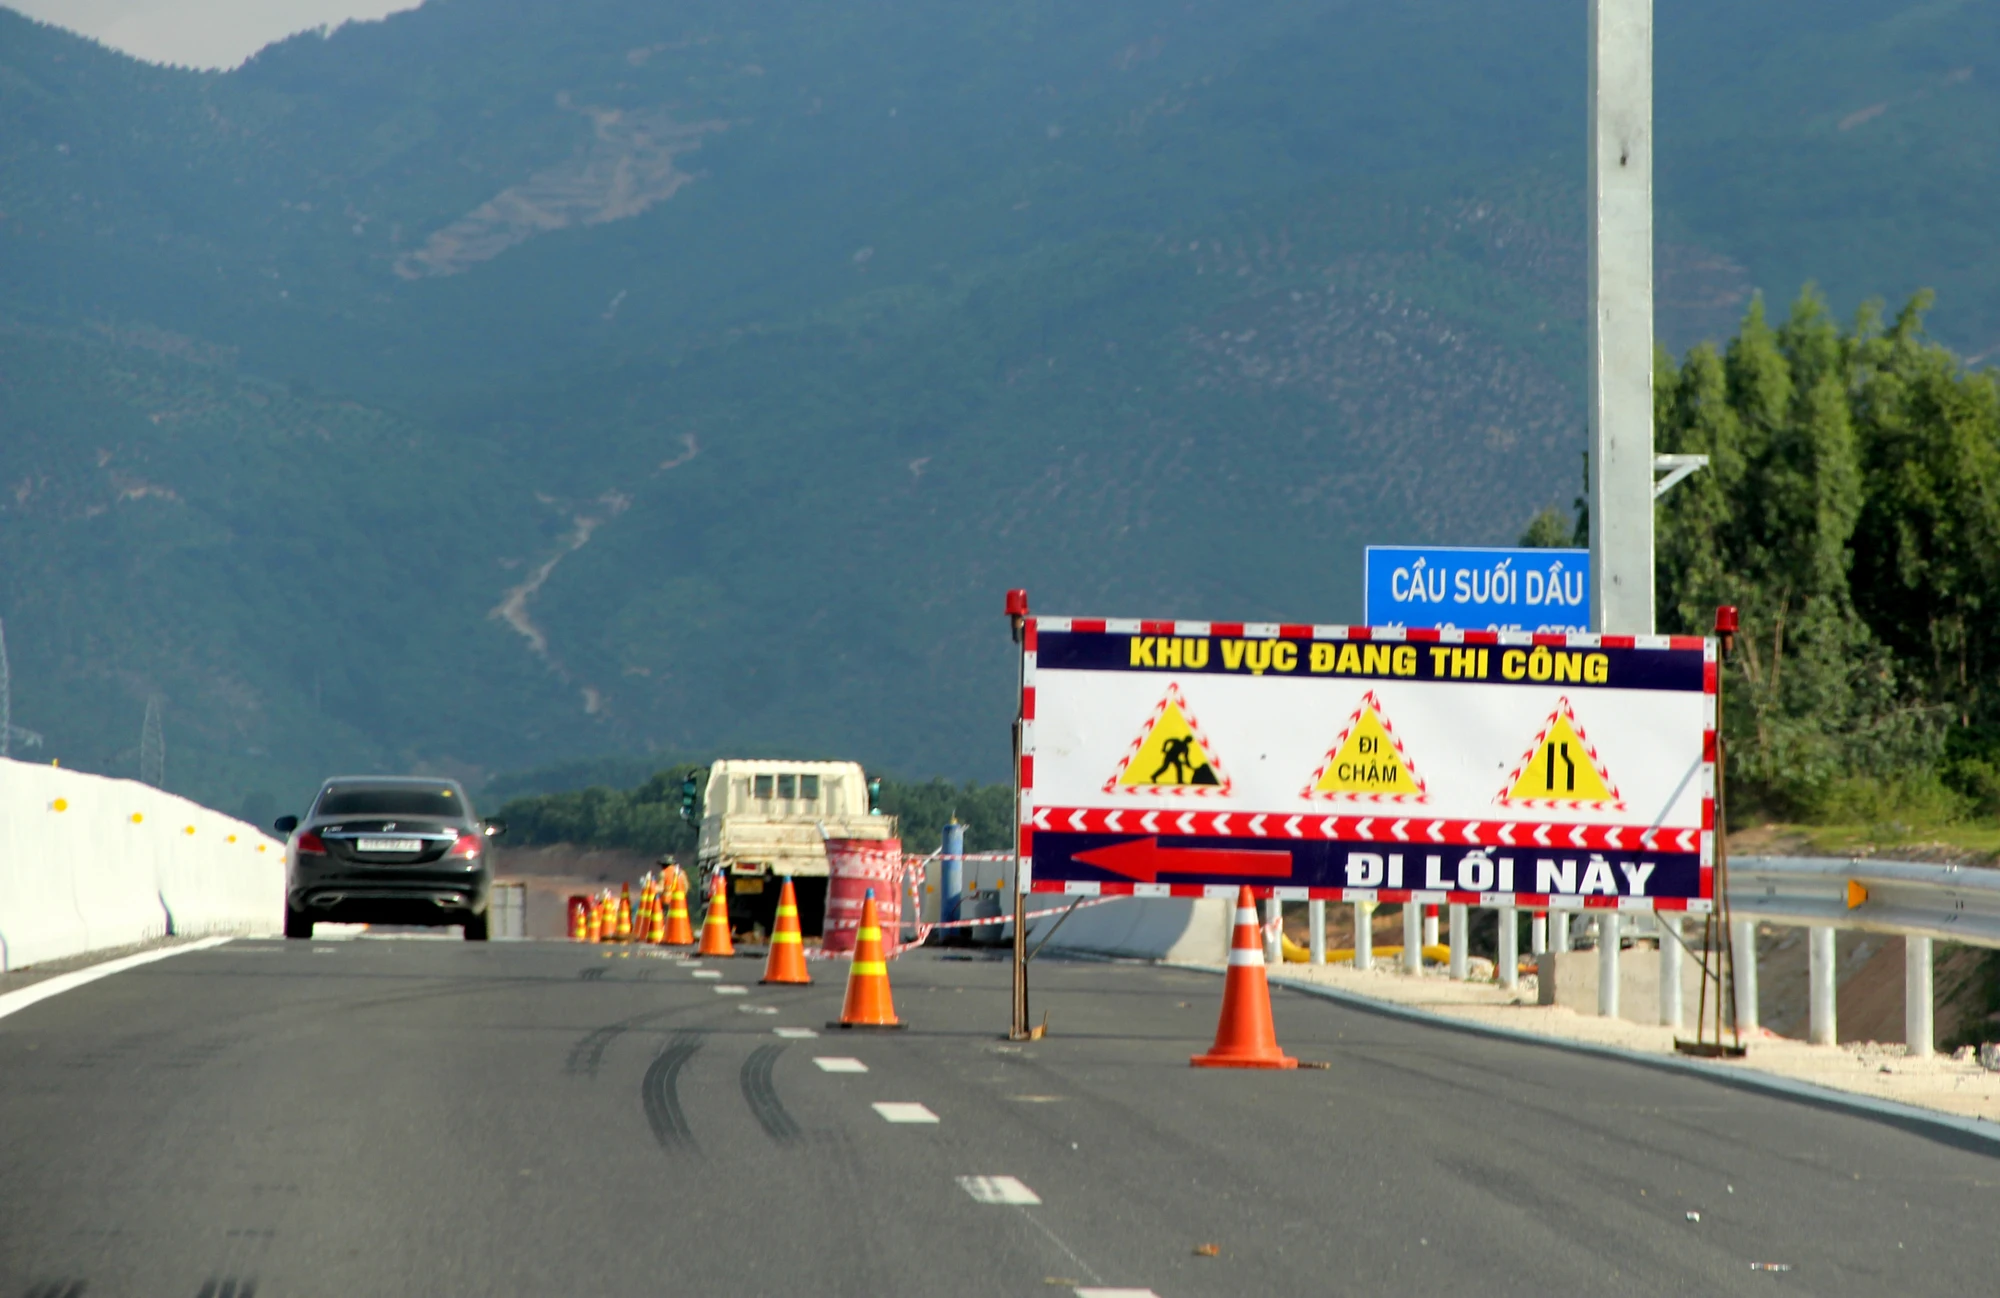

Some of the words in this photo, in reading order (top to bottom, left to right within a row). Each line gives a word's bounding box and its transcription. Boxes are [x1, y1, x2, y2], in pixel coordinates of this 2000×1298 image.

[1392, 556, 1446, 603] CẦU
[1453, 557, 1517, 605] SUỐI
[1526, 560, 1583, 606] DẦU
[1130, 636, 1209, 669] KHU
[1220, 638, 1298, 676] VỰC
[1309, 642, 1417, 676] ĐANG
[1429, 647, 1489, 679] THI
[1502, 644, 1609, 683] CÔNG
[1359, 736, 1378, 754] ĐI
[1338, 758, 1397, 788] CHẬM
[1344, 852, 1404, 888] ĐI
[1425, 846, 1515, 892] LỐI
[1536, 853, 1656, 897] NÀY
